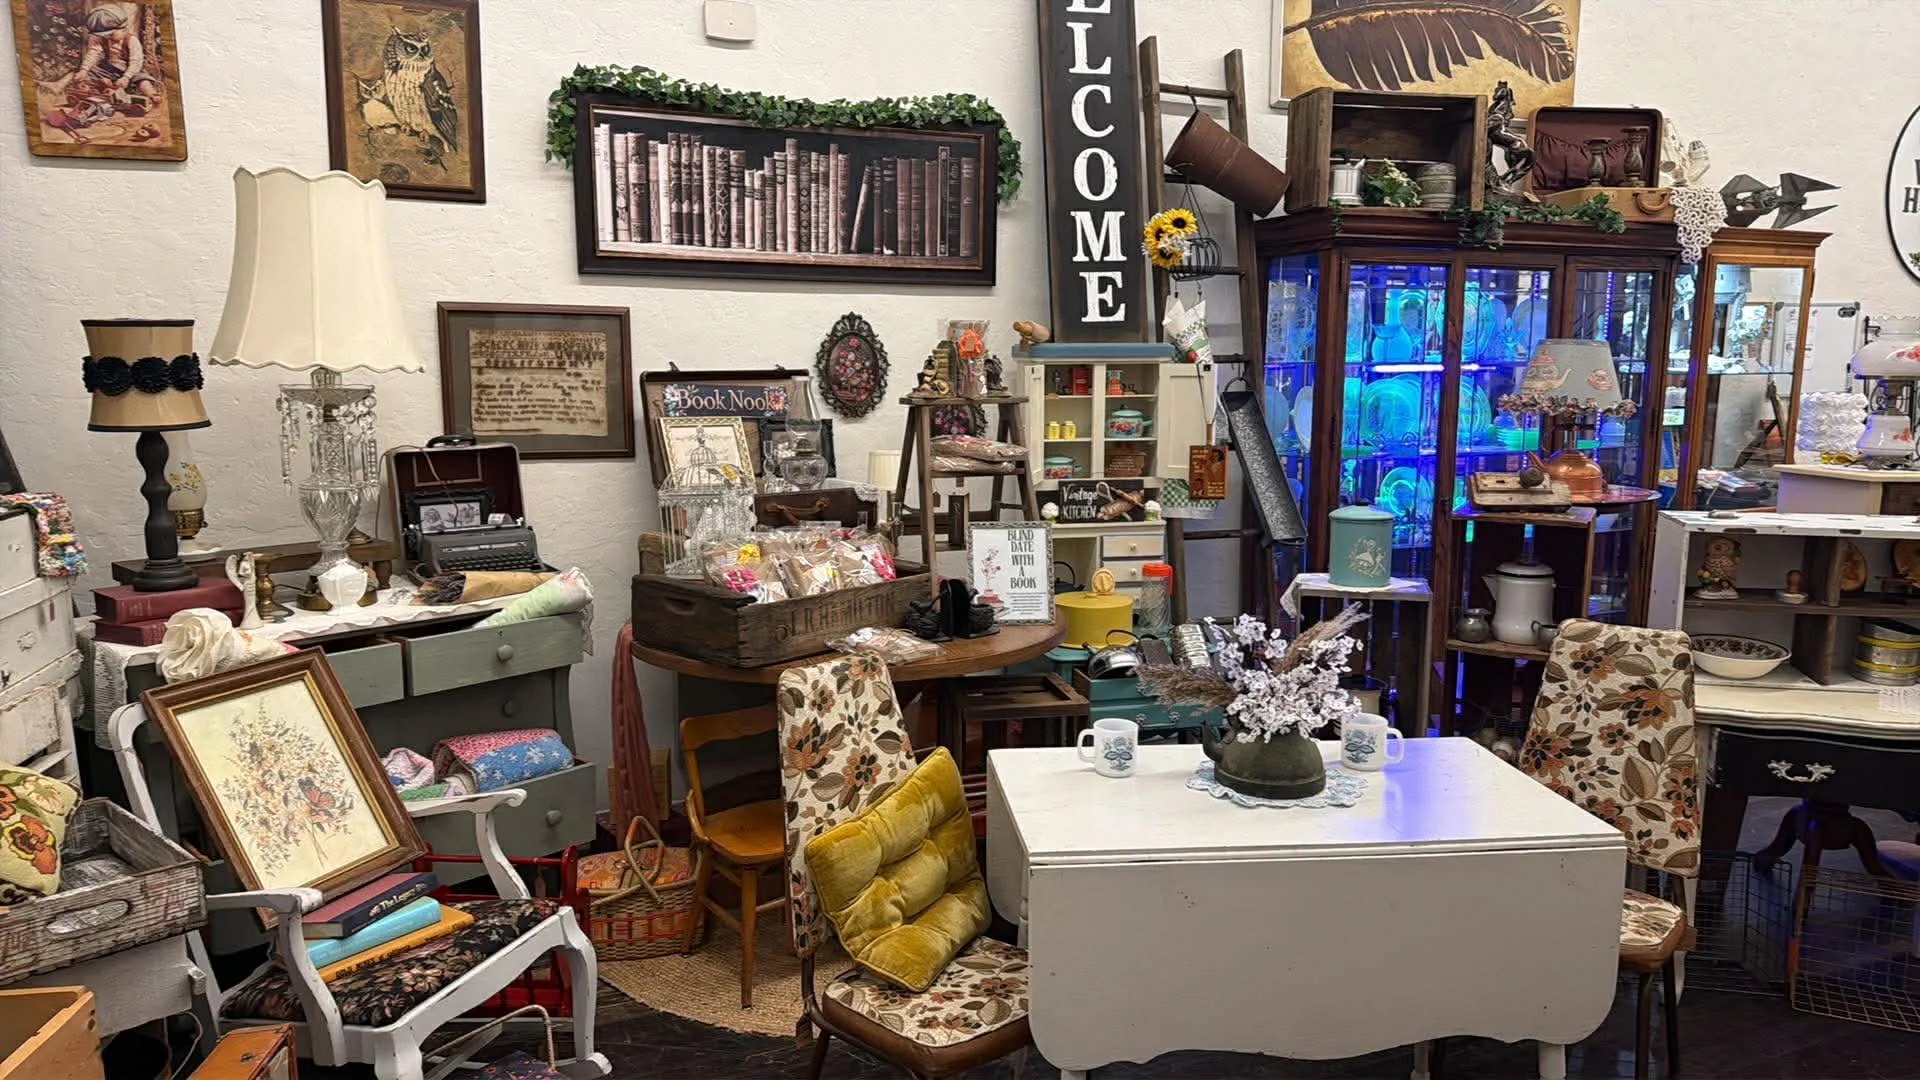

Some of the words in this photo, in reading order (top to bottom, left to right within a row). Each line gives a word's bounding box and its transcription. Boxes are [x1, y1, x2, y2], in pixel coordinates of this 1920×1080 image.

[1065, 0, 1128, 322] LCOME
[678, 388, 728, 411] Book
[728, 389, 776, 412] Nook
[1063, 483, 1098, 505] Vintage
[1062, 505, 1097, 519] KITCHEN
[1008, 529, 1034, 541] BLIND
[1011, 541, 1035, 553] DATE
[1011, 554, 1035, 566] WITH
[1019, 565, 1025, 577] A
[1010, 577, 1037, 589] BOOK
